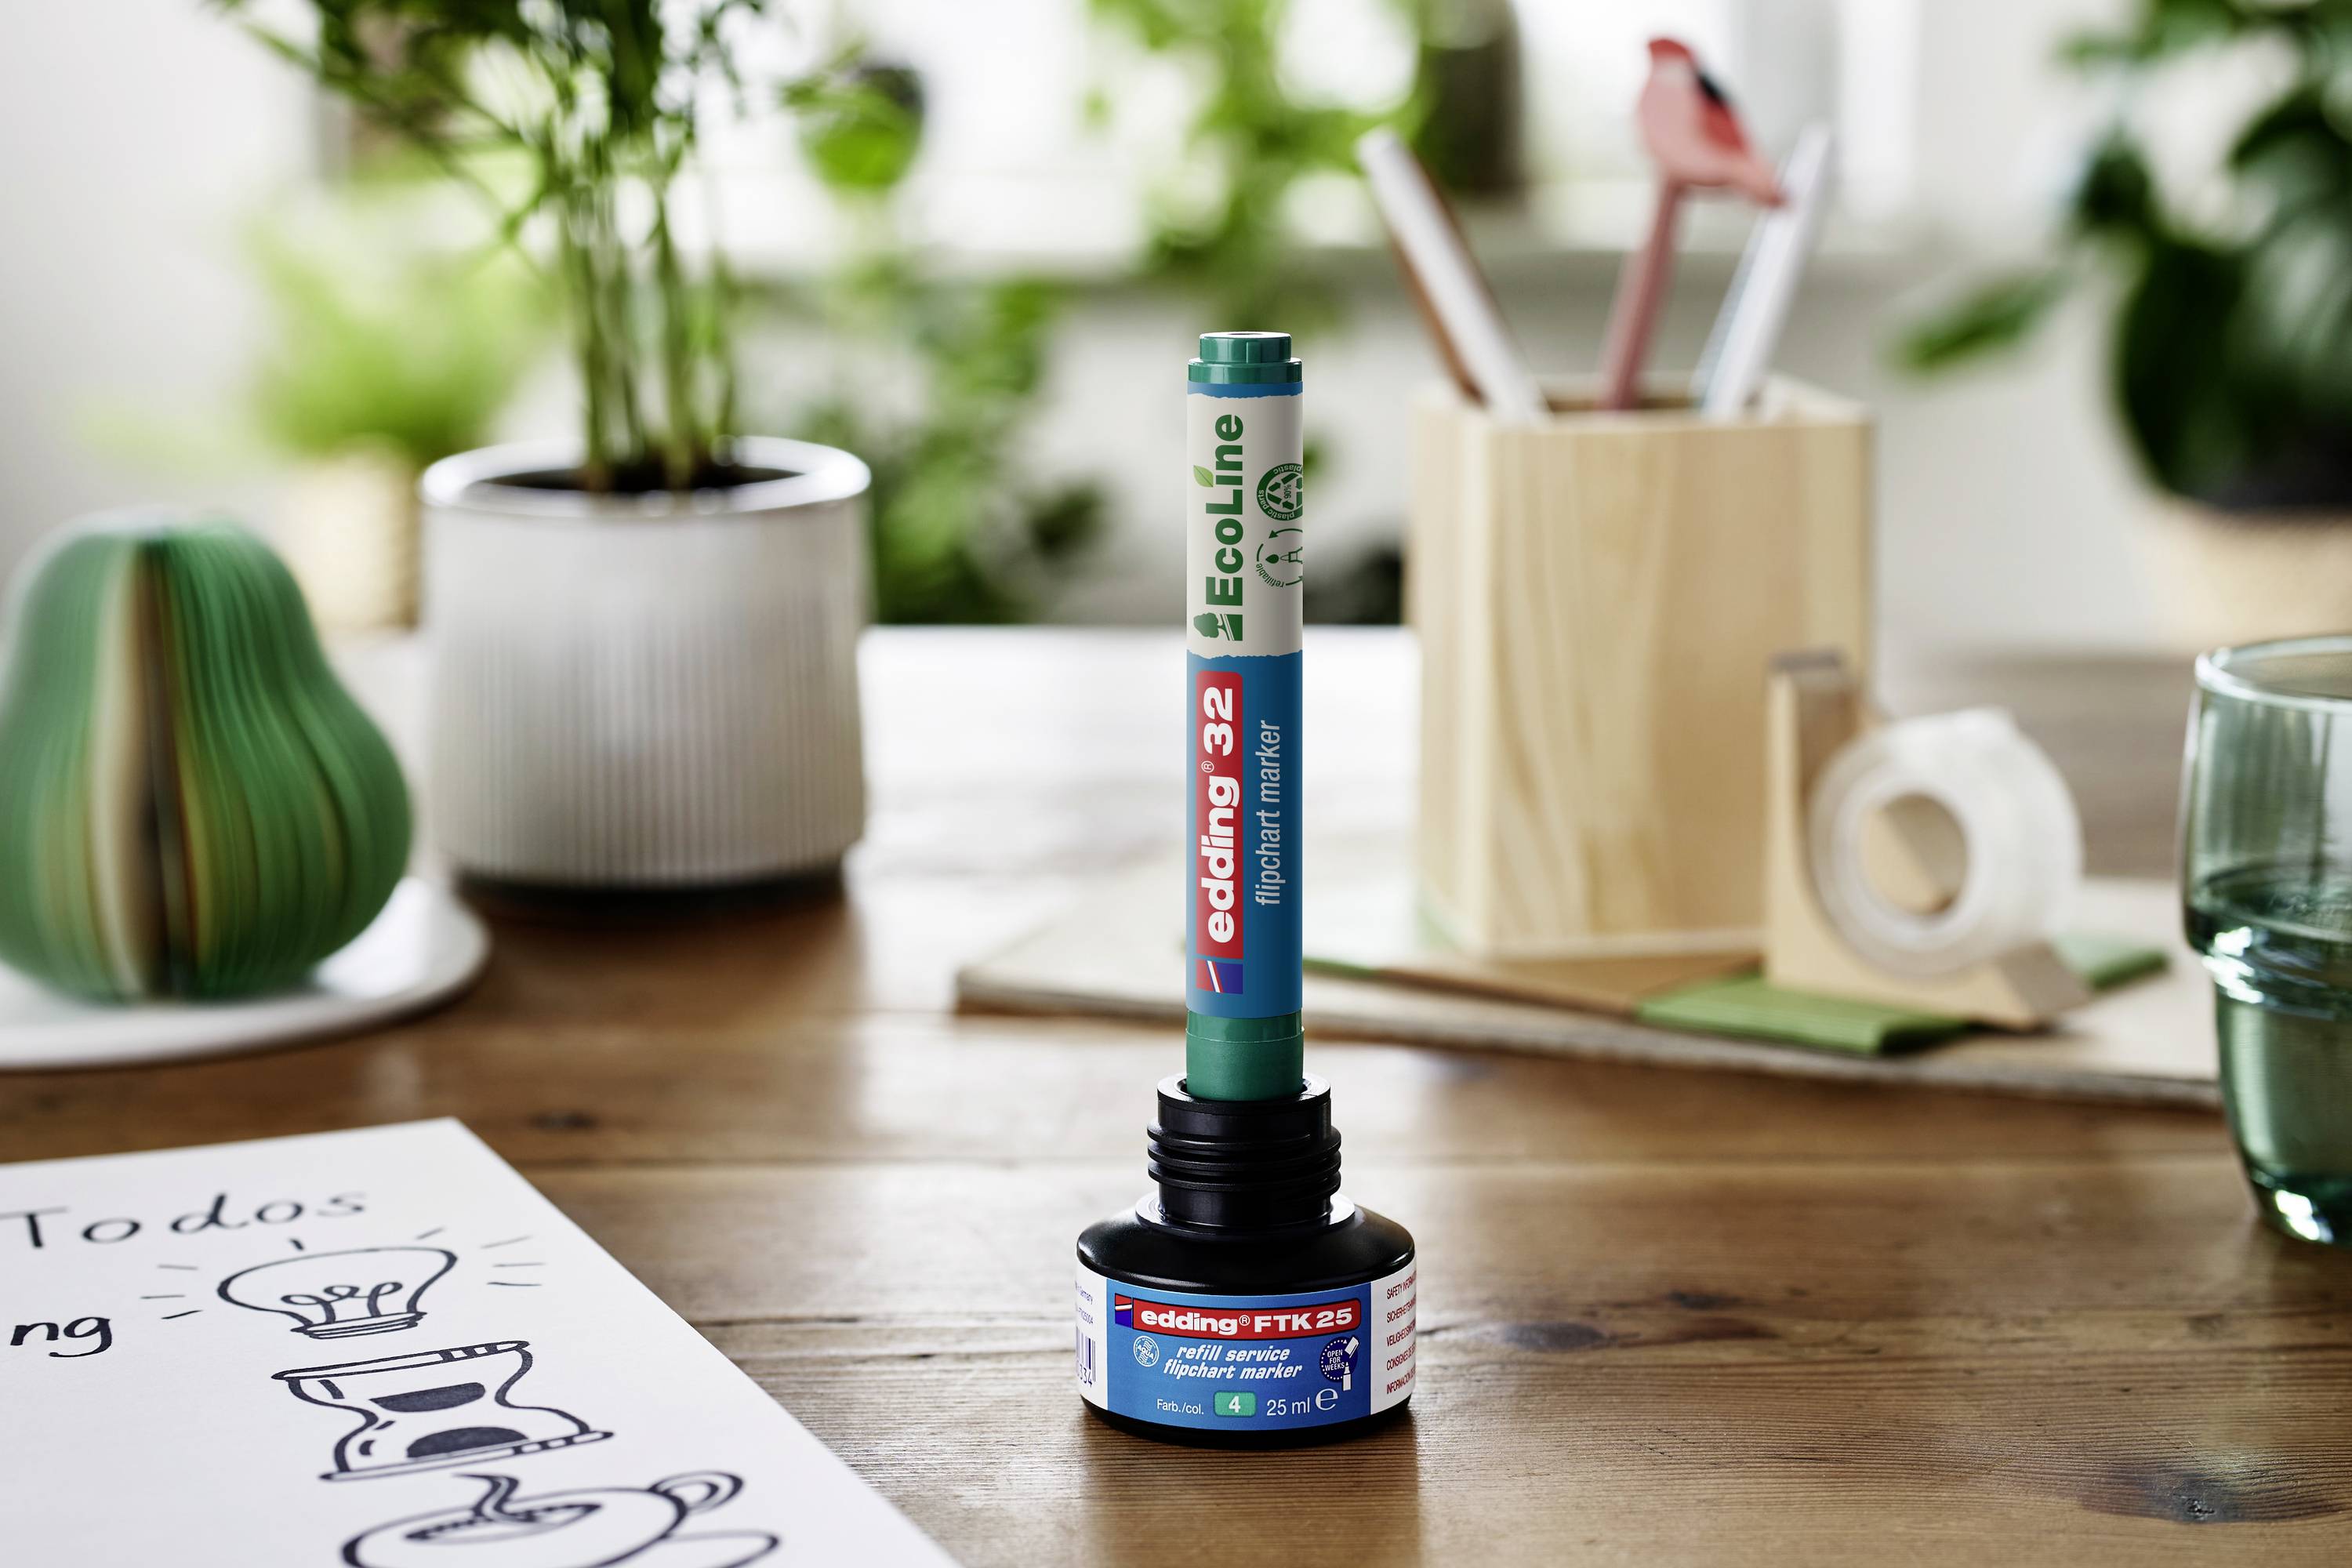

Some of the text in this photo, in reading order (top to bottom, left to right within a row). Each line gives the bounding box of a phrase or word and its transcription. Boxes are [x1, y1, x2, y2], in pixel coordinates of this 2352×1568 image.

[1283, 484, 1292, 499] 90%
[1193, 413, 1244, 607] EcoLine
[1258, 489, 1295, 521] plastic parts
[1256, 563, 1285, 588] refillable
[1203, 686, 1234, 757] 32
[1255, 720, 1287, 906] flipchart marker
[1387, 1283, 1403, 1299] SAFETY
[1254, 1313, 1312, 1333] FTK
[1316, 1308, 1352, 1329] 25
[1177, 1344, 1290, 1362] refill service
[1327, 1349, 1343, 1358] OPEN
[1163, 1359, 1302, 1380] flipchart marker
[1325, 1362, 1345, 1371] WEEKS
[1156, 1399, 1204, 1415] Farb./col.
[1229, 1396, 1241, 1413] 4
[1266, 1399, 1287, 1416] 25
[1291, 1397, 1310, 1414] ml
